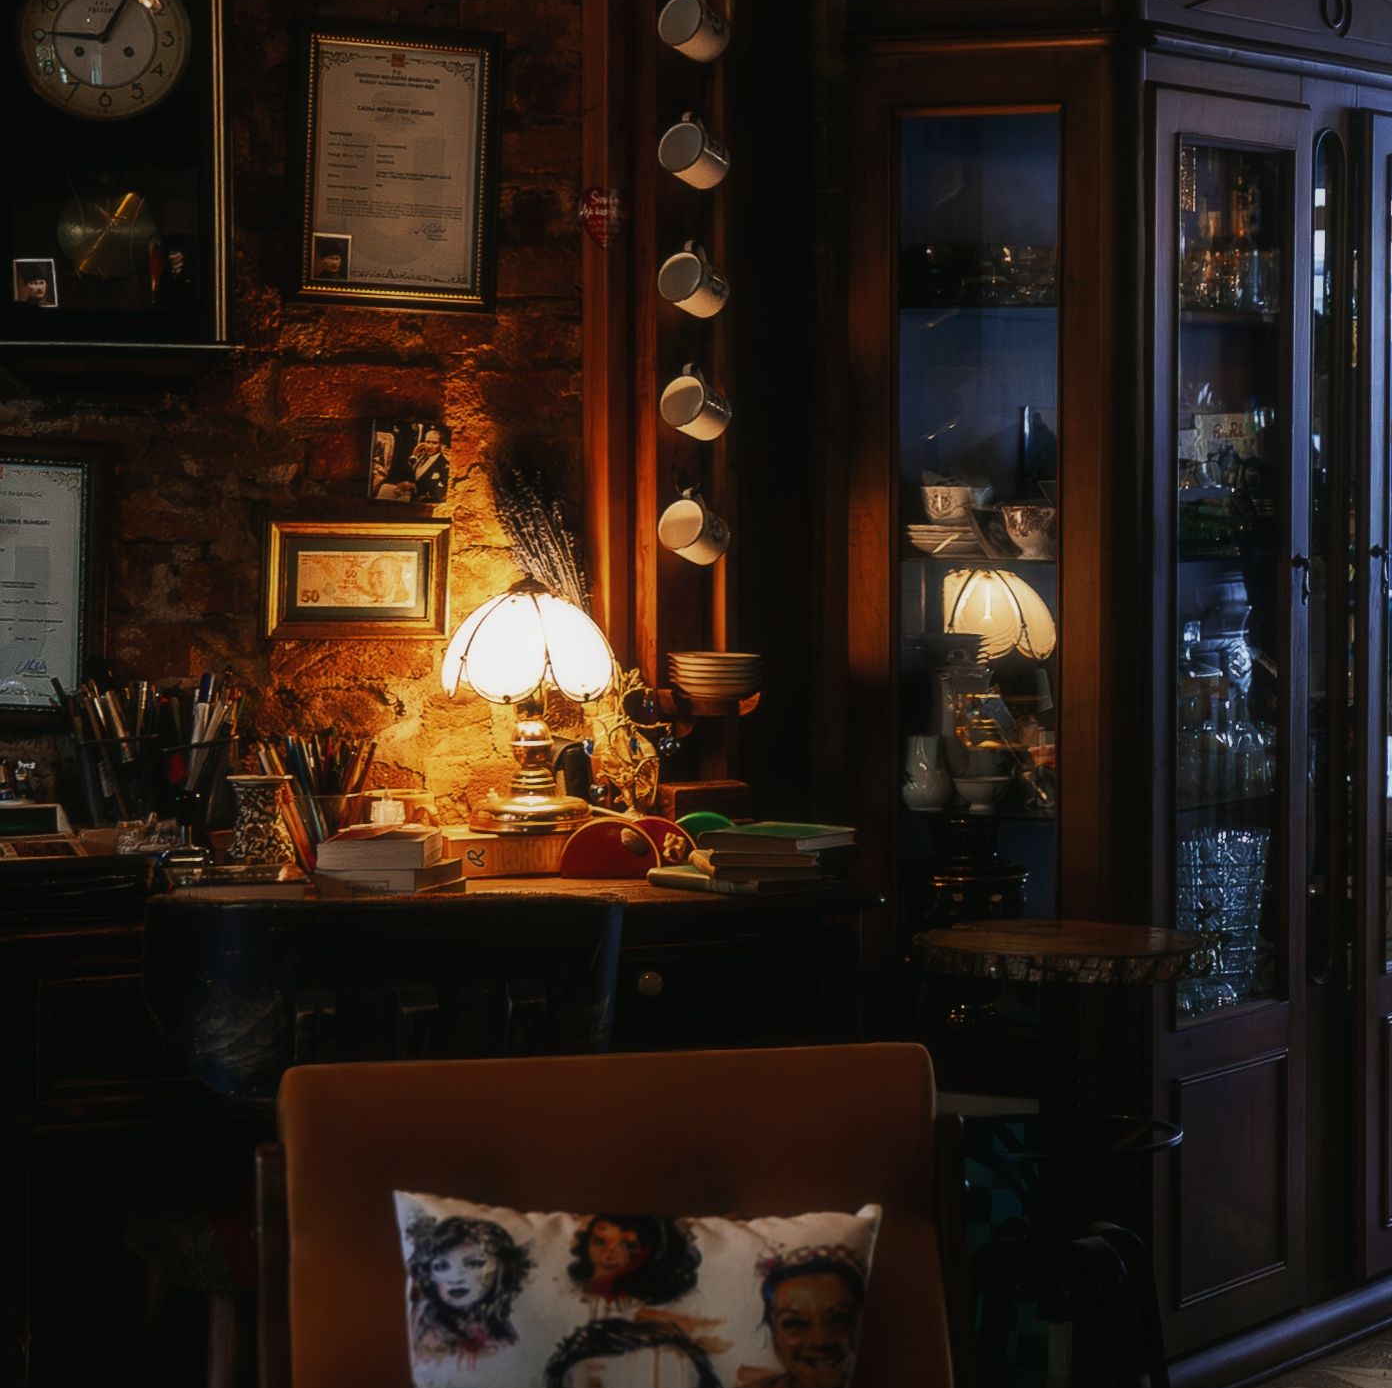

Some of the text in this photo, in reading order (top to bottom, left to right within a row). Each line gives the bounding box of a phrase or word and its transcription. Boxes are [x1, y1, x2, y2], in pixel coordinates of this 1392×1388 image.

[161, 31, 175, 47] 3
[151, 62, 163, 77] 4
[65, 81, 79, 101] 7
[98, 90, 112, 107] 6
[131, 82, 144, 100] 5
[301, 590, 319, 603] 50
